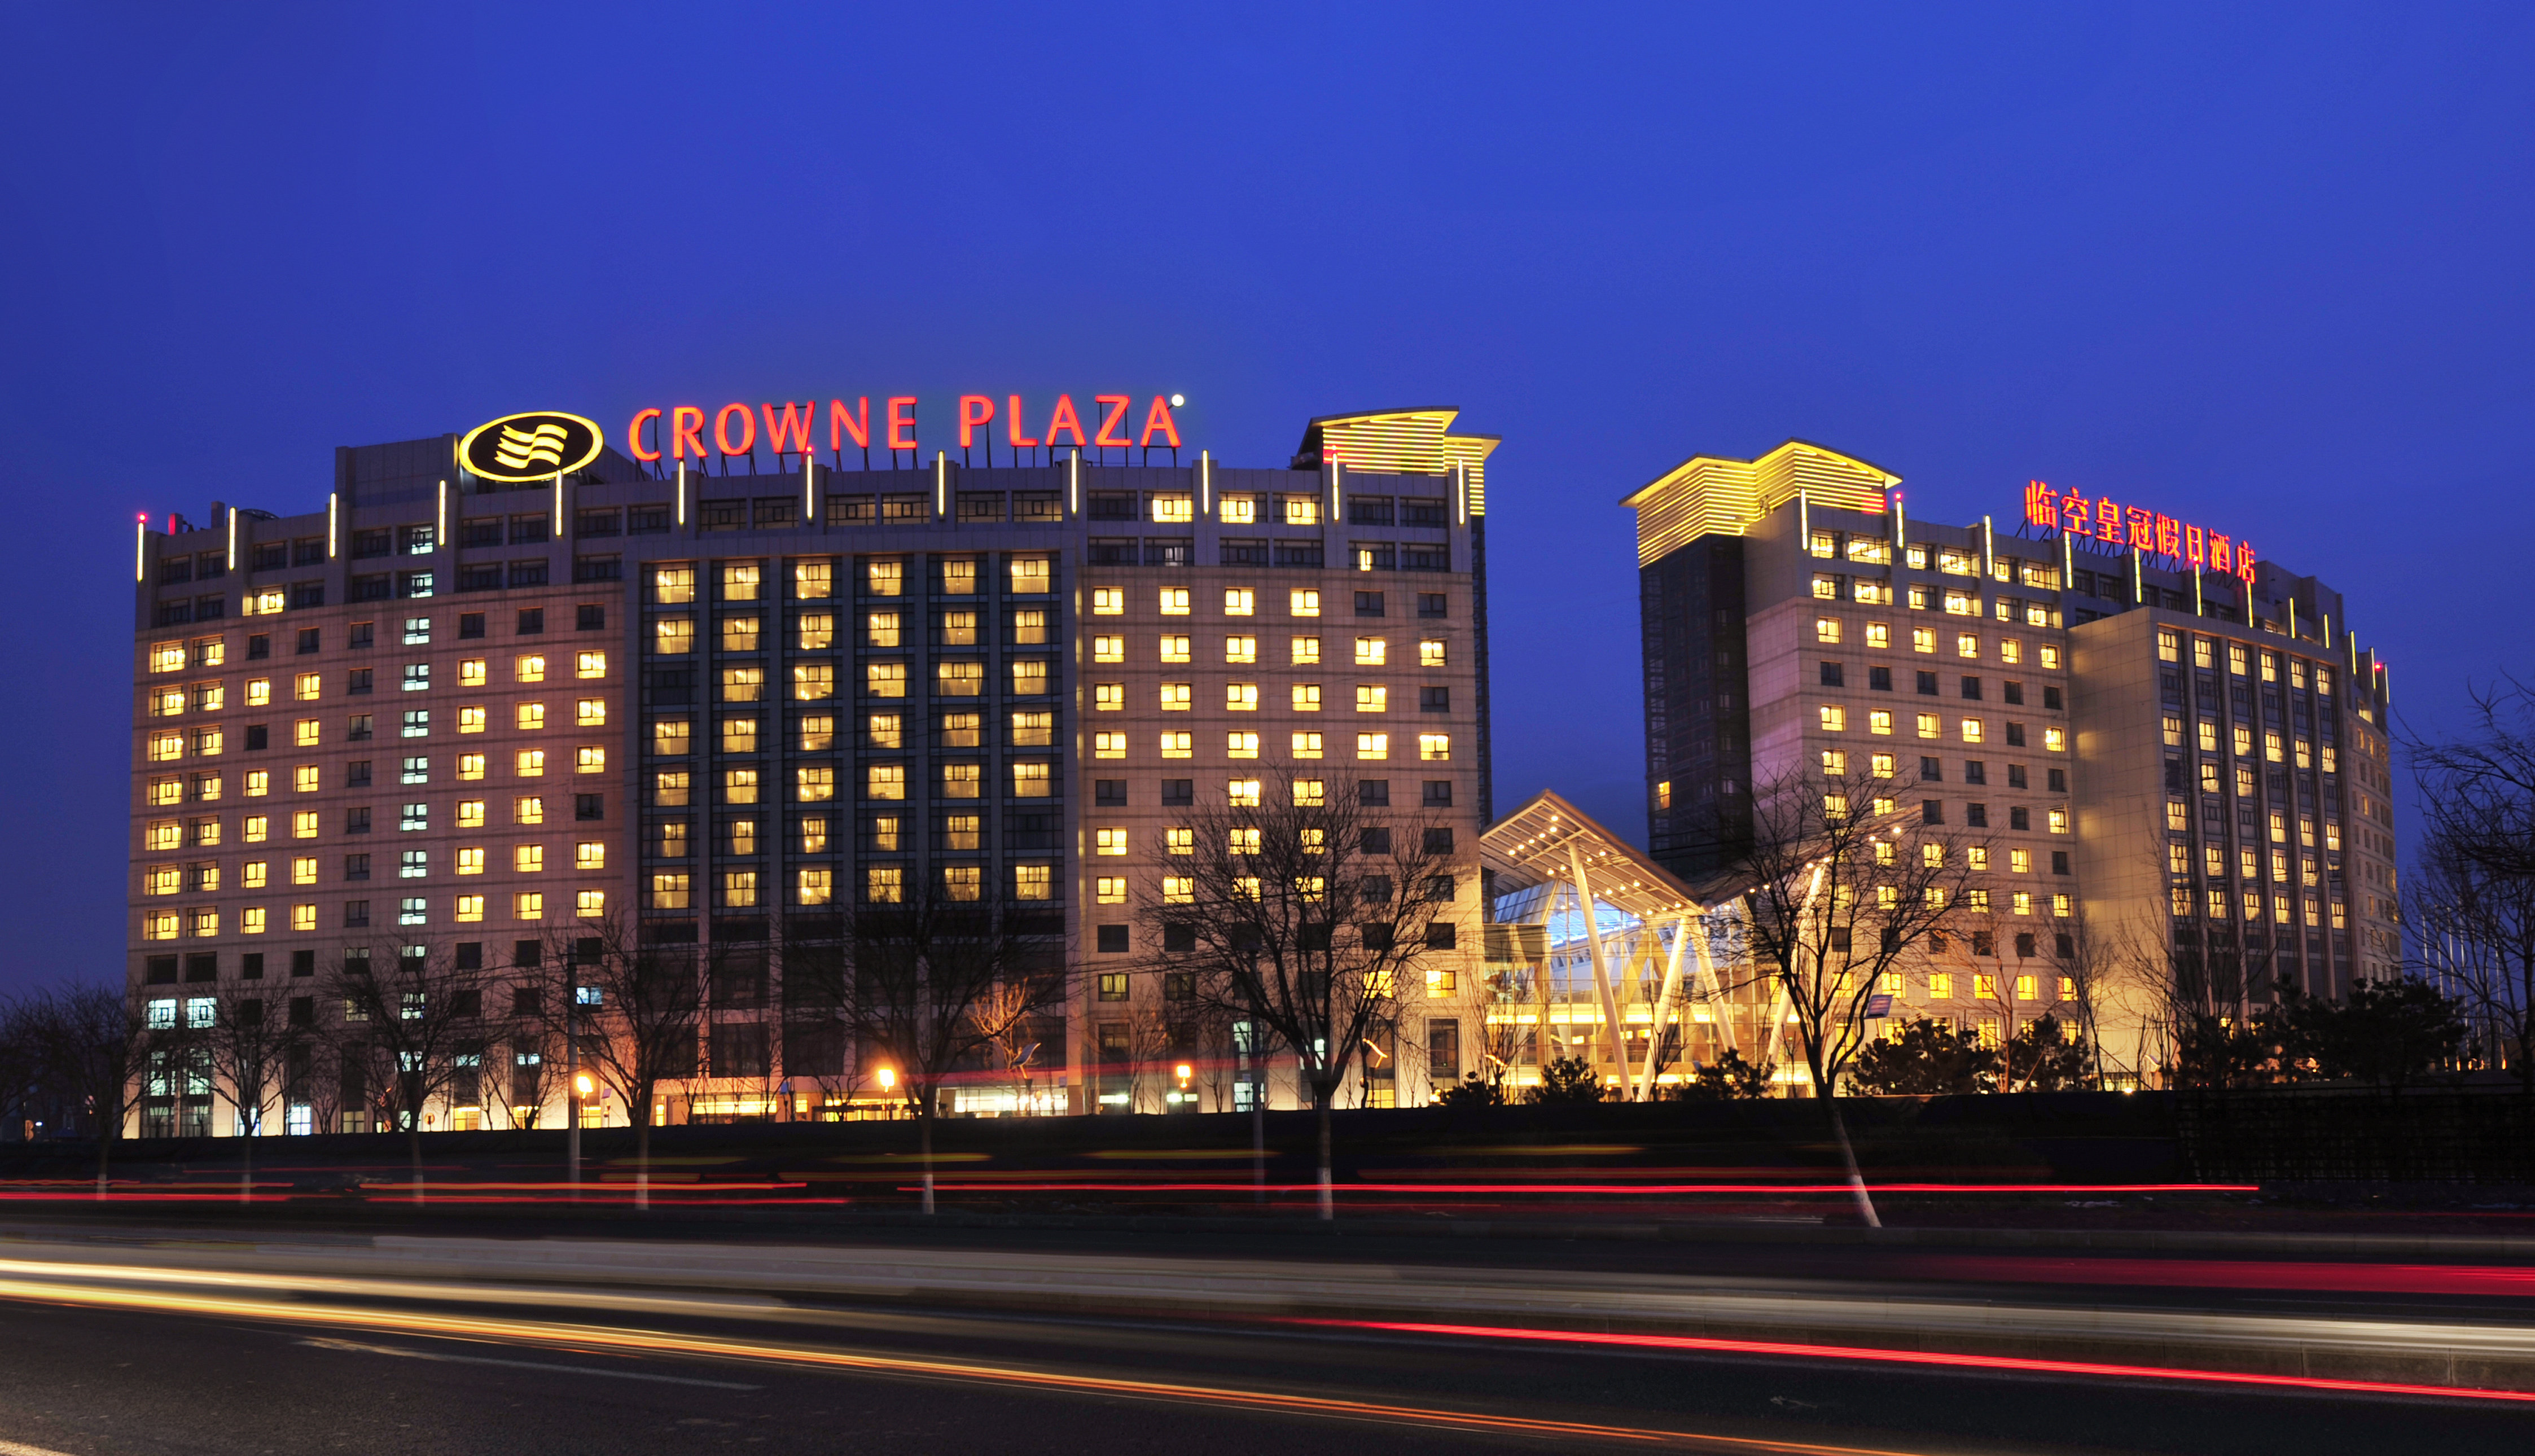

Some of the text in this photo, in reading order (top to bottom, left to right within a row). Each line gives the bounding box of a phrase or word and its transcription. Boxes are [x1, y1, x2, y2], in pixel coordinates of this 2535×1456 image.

[629, 394, 1181, 461] CROWNE PLAZA
[2024, 480, 2255, 584] 临空皇冠假日酒店
